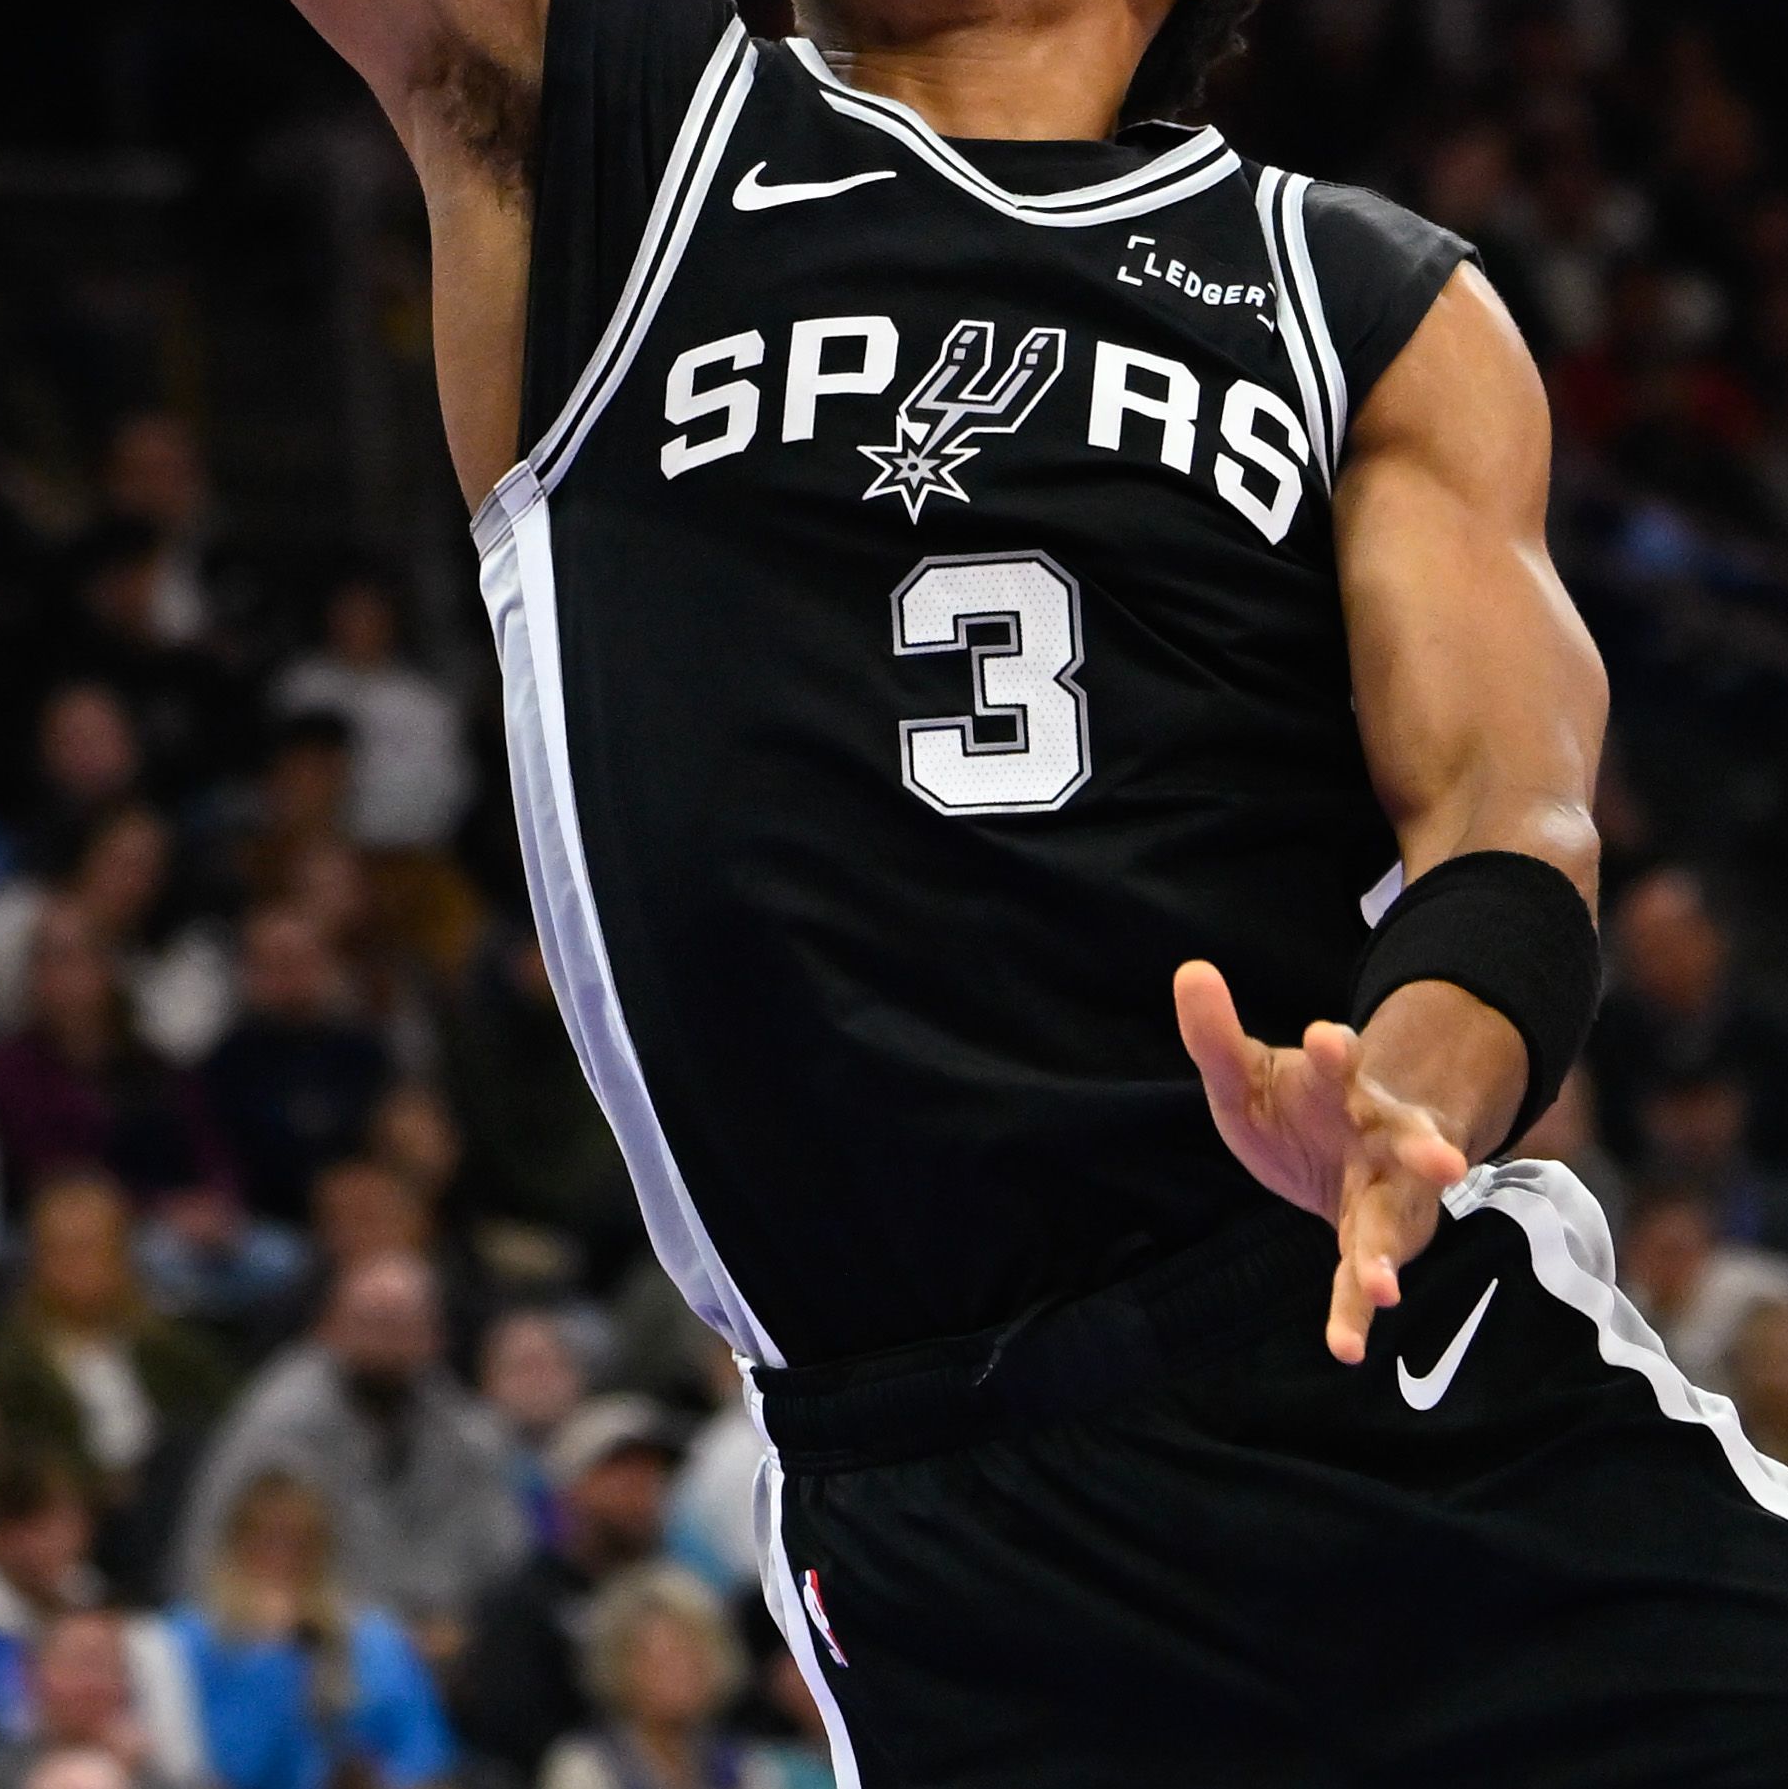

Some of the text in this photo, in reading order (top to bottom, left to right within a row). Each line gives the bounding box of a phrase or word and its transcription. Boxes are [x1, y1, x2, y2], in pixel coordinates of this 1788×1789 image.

[1143, 251, 1266, 309] LEDGER
[659, 315, 1310, 546] SPURS
[888, 548, 1093, 816] 3
